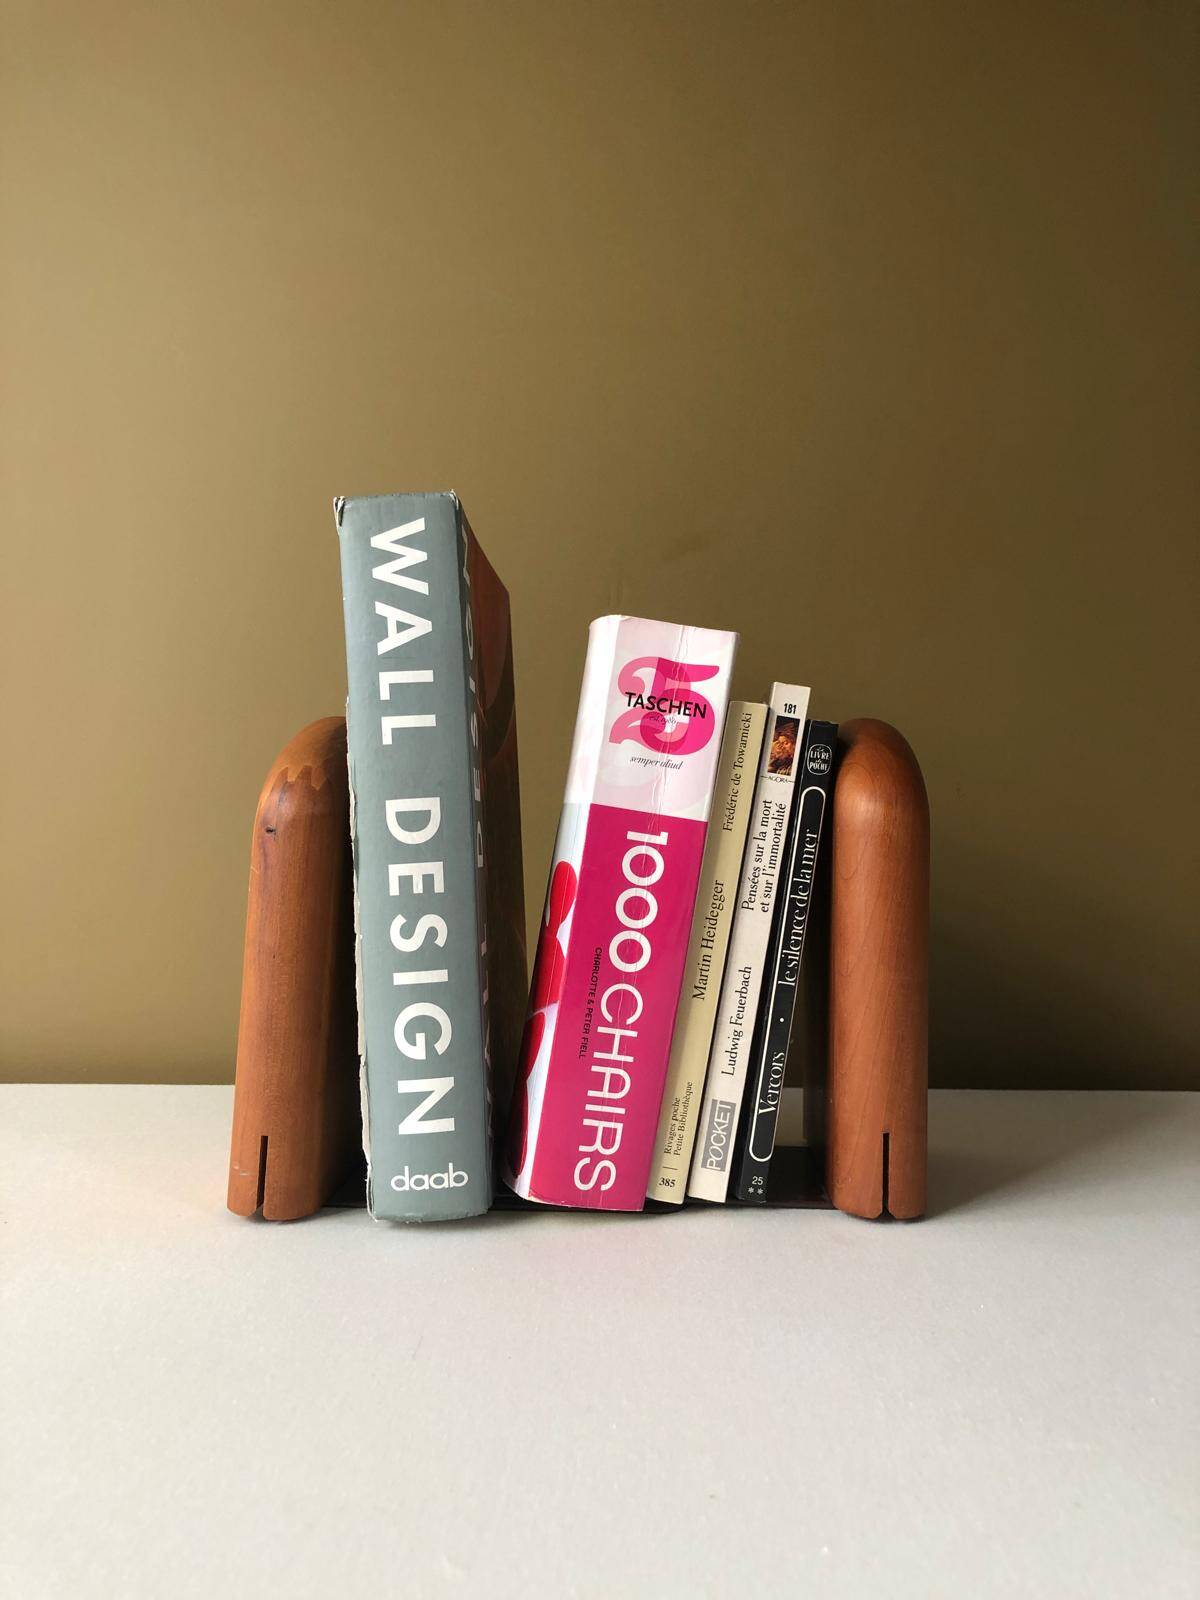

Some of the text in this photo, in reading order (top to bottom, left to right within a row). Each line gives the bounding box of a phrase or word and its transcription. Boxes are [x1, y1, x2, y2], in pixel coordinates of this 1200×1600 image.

[625, 692, 707, 718] TASCHEN
[784, 703, 797, 715] 181
[630, 756, 660, 768] semper
[723, 712, 752, 832] Frédéric de Towarnicki
[809, 762, 828, 771] POCHE
[810, 751, 829, 760] LIVRE
[371, 517, 455, 1135] WALL DESIGN
[741, 799, 772, 911] Pensées sur la mort
[761, 901, 769, 913] et
[764, 880, 774, 899] sur
[778, 829, 817, 986] le silence de la mer
[692, 879, 725, 1000] Martin Heidegger
[588, 947, 602, 997] CHARLOTTE
[574, 831, 669, 1192] 1000 CHAIRS
[582, 1007, 593, 1034] PETER
[721, 966, 751, 1076] Ludwig Feuerbach
[578, 1037, 589, 1059] FIELL
[759, 1052, 785, 1115] Vercors
[664, 1096, 681, 1155] Rivages poche
[673, 1081, 692, 1156] Petite Bibliothèque
[707, 1101, 732, 1171] POCKET
[390, 1163, 468, 1191] daab
[659, 1177, 676, 1188] 385
[752, 1176, 763, 1185] 25
